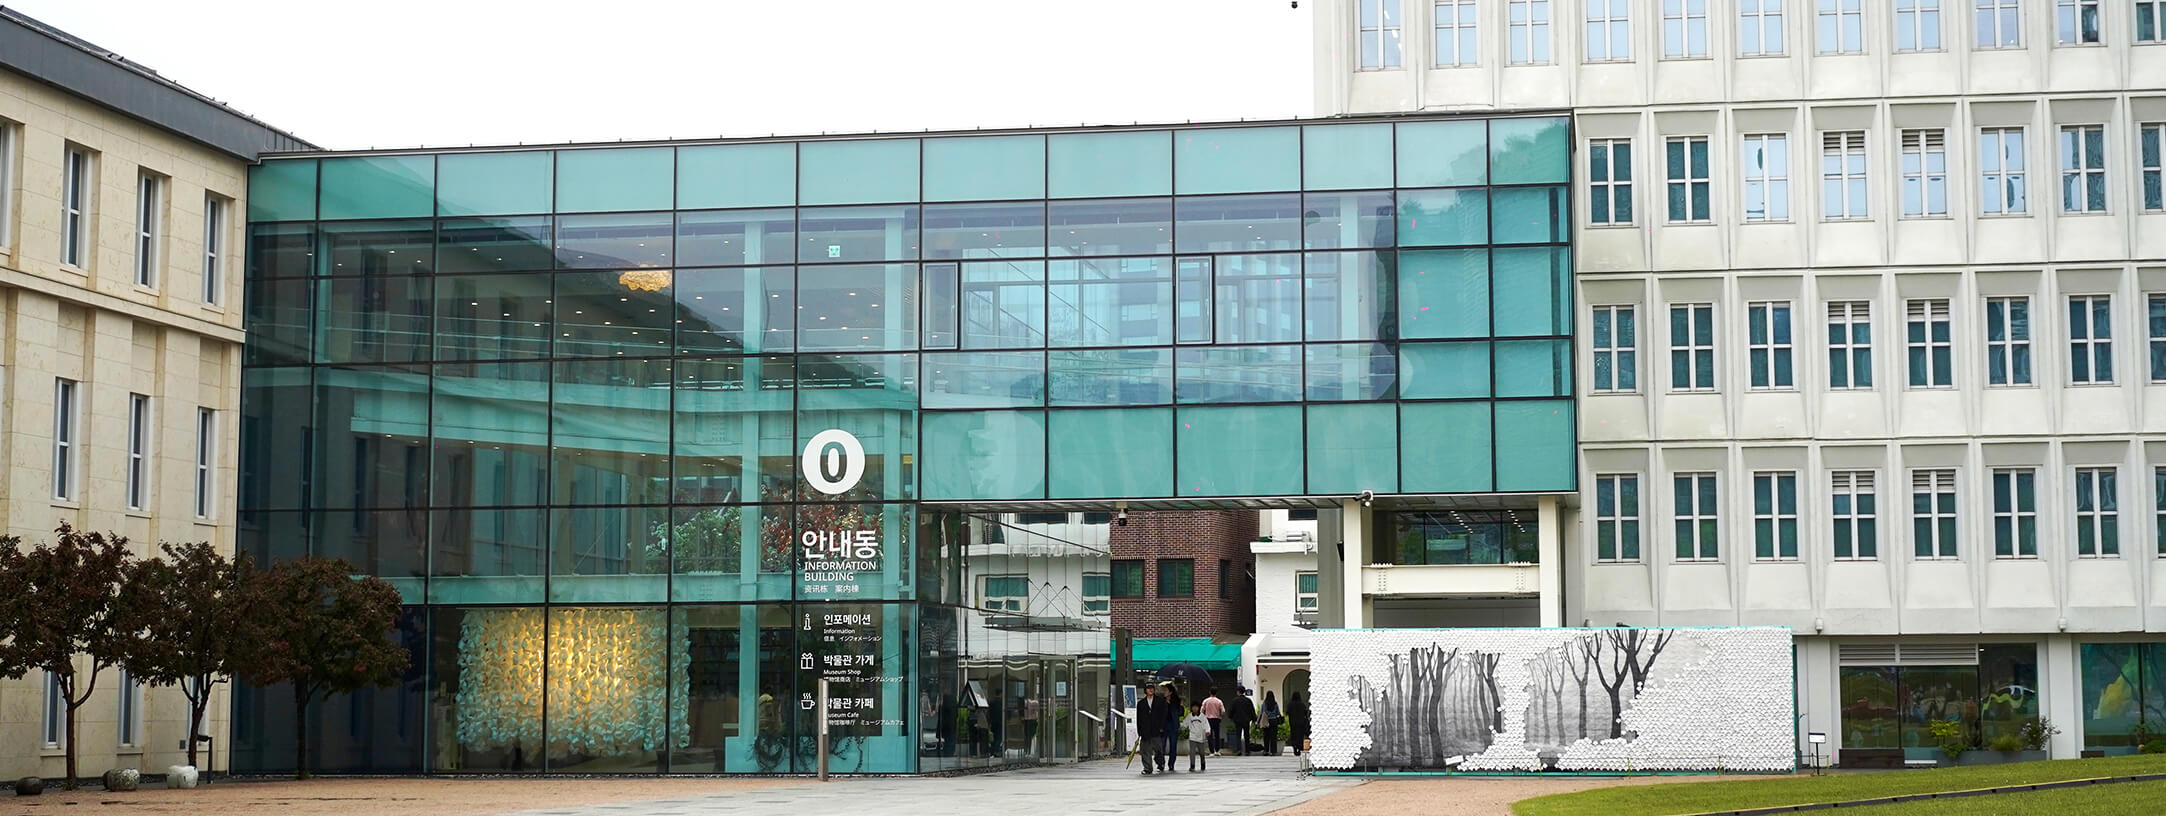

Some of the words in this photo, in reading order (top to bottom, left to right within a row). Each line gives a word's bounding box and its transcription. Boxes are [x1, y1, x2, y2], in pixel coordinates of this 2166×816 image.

[802, 531, 878, 559] 안내동
[804, 561, 877, 570] INFORMATION
[804, 572, 854, 581] BUILDING
[823, 614, 871, 625] 인포메이션
[823, 654, 853, 666] 박물관
[855, 654, 874, 666] 가게
[855, 697, 874, 709] 카페
